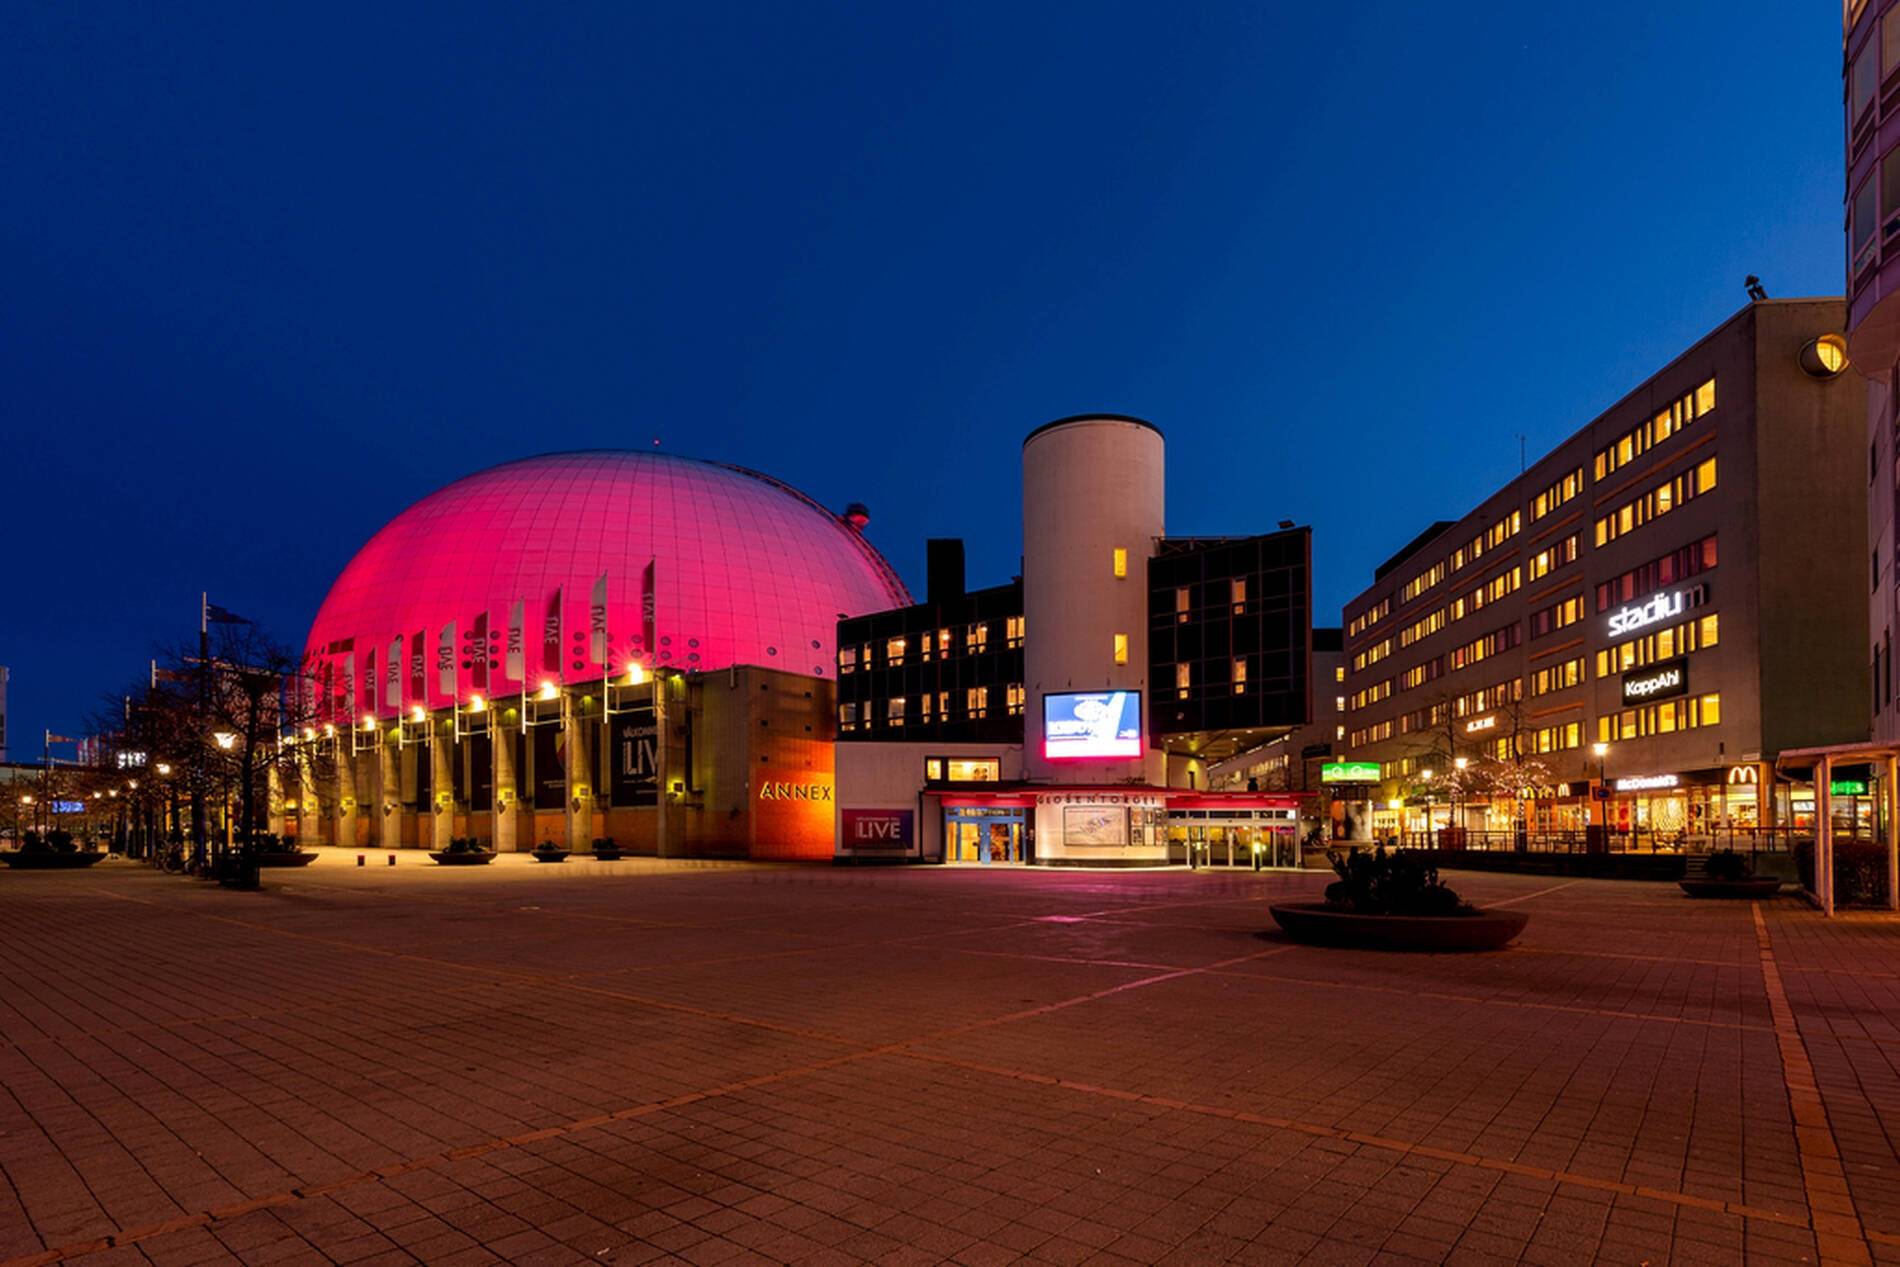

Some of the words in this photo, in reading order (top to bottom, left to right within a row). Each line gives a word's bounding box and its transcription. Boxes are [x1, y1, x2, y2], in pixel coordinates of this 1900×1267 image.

[1607, 583, 1704, 637] stadium
[1625, 669, 1679, 696] KappAhl
[623, 739, 657, 775] LIV
[759, 781, 831, 801] ANNEX
[1616, 774, 1678, 791] McDonald's
[855, 821, 901, 839] LIVE
